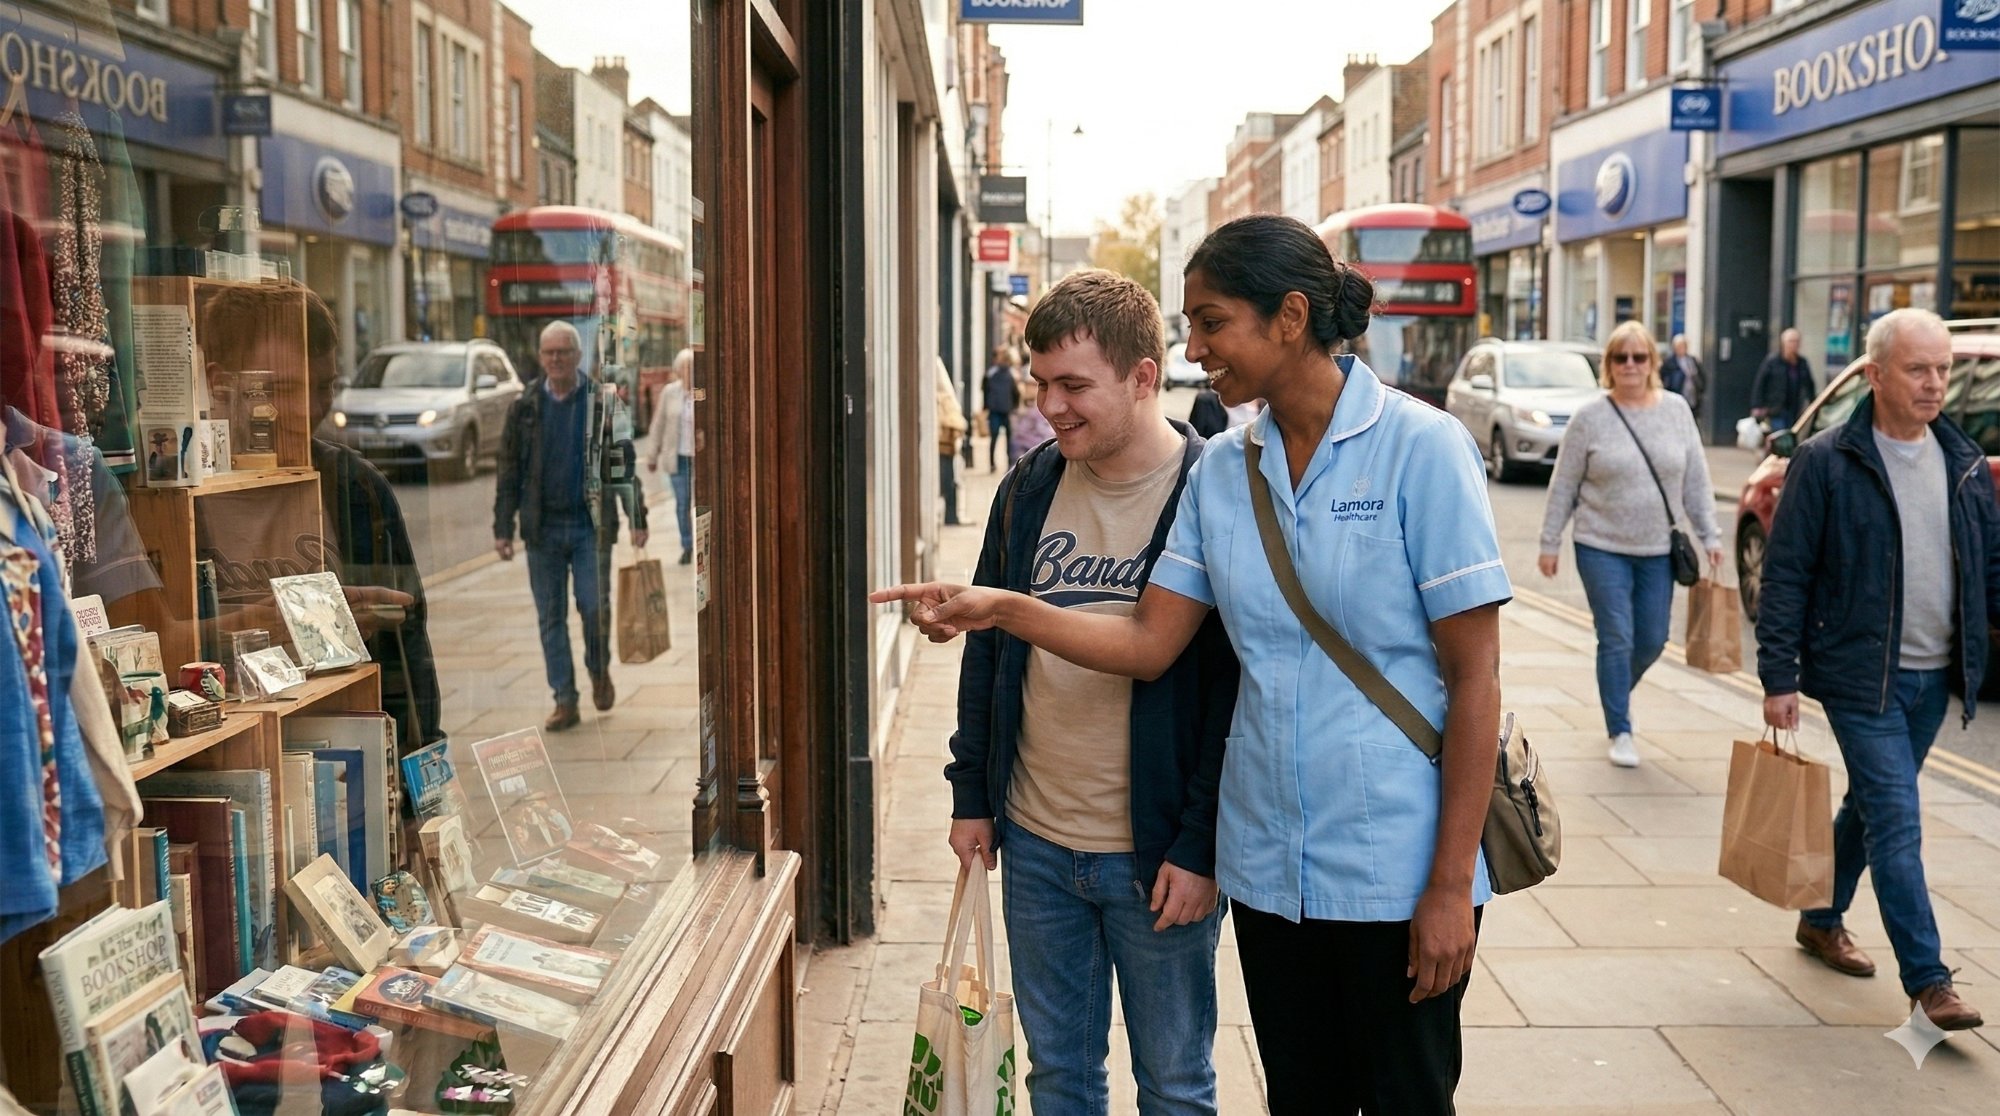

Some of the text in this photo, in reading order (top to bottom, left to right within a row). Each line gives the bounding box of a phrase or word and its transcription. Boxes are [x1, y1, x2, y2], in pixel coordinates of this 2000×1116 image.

[1772, 15, 1950, 115] BOOKSHO
[1331, 498, 1384, 512] Lamora
[1333, 512, 1378, 522] Healthcare
[81, 934, 167, 997] BOOKSHOP
